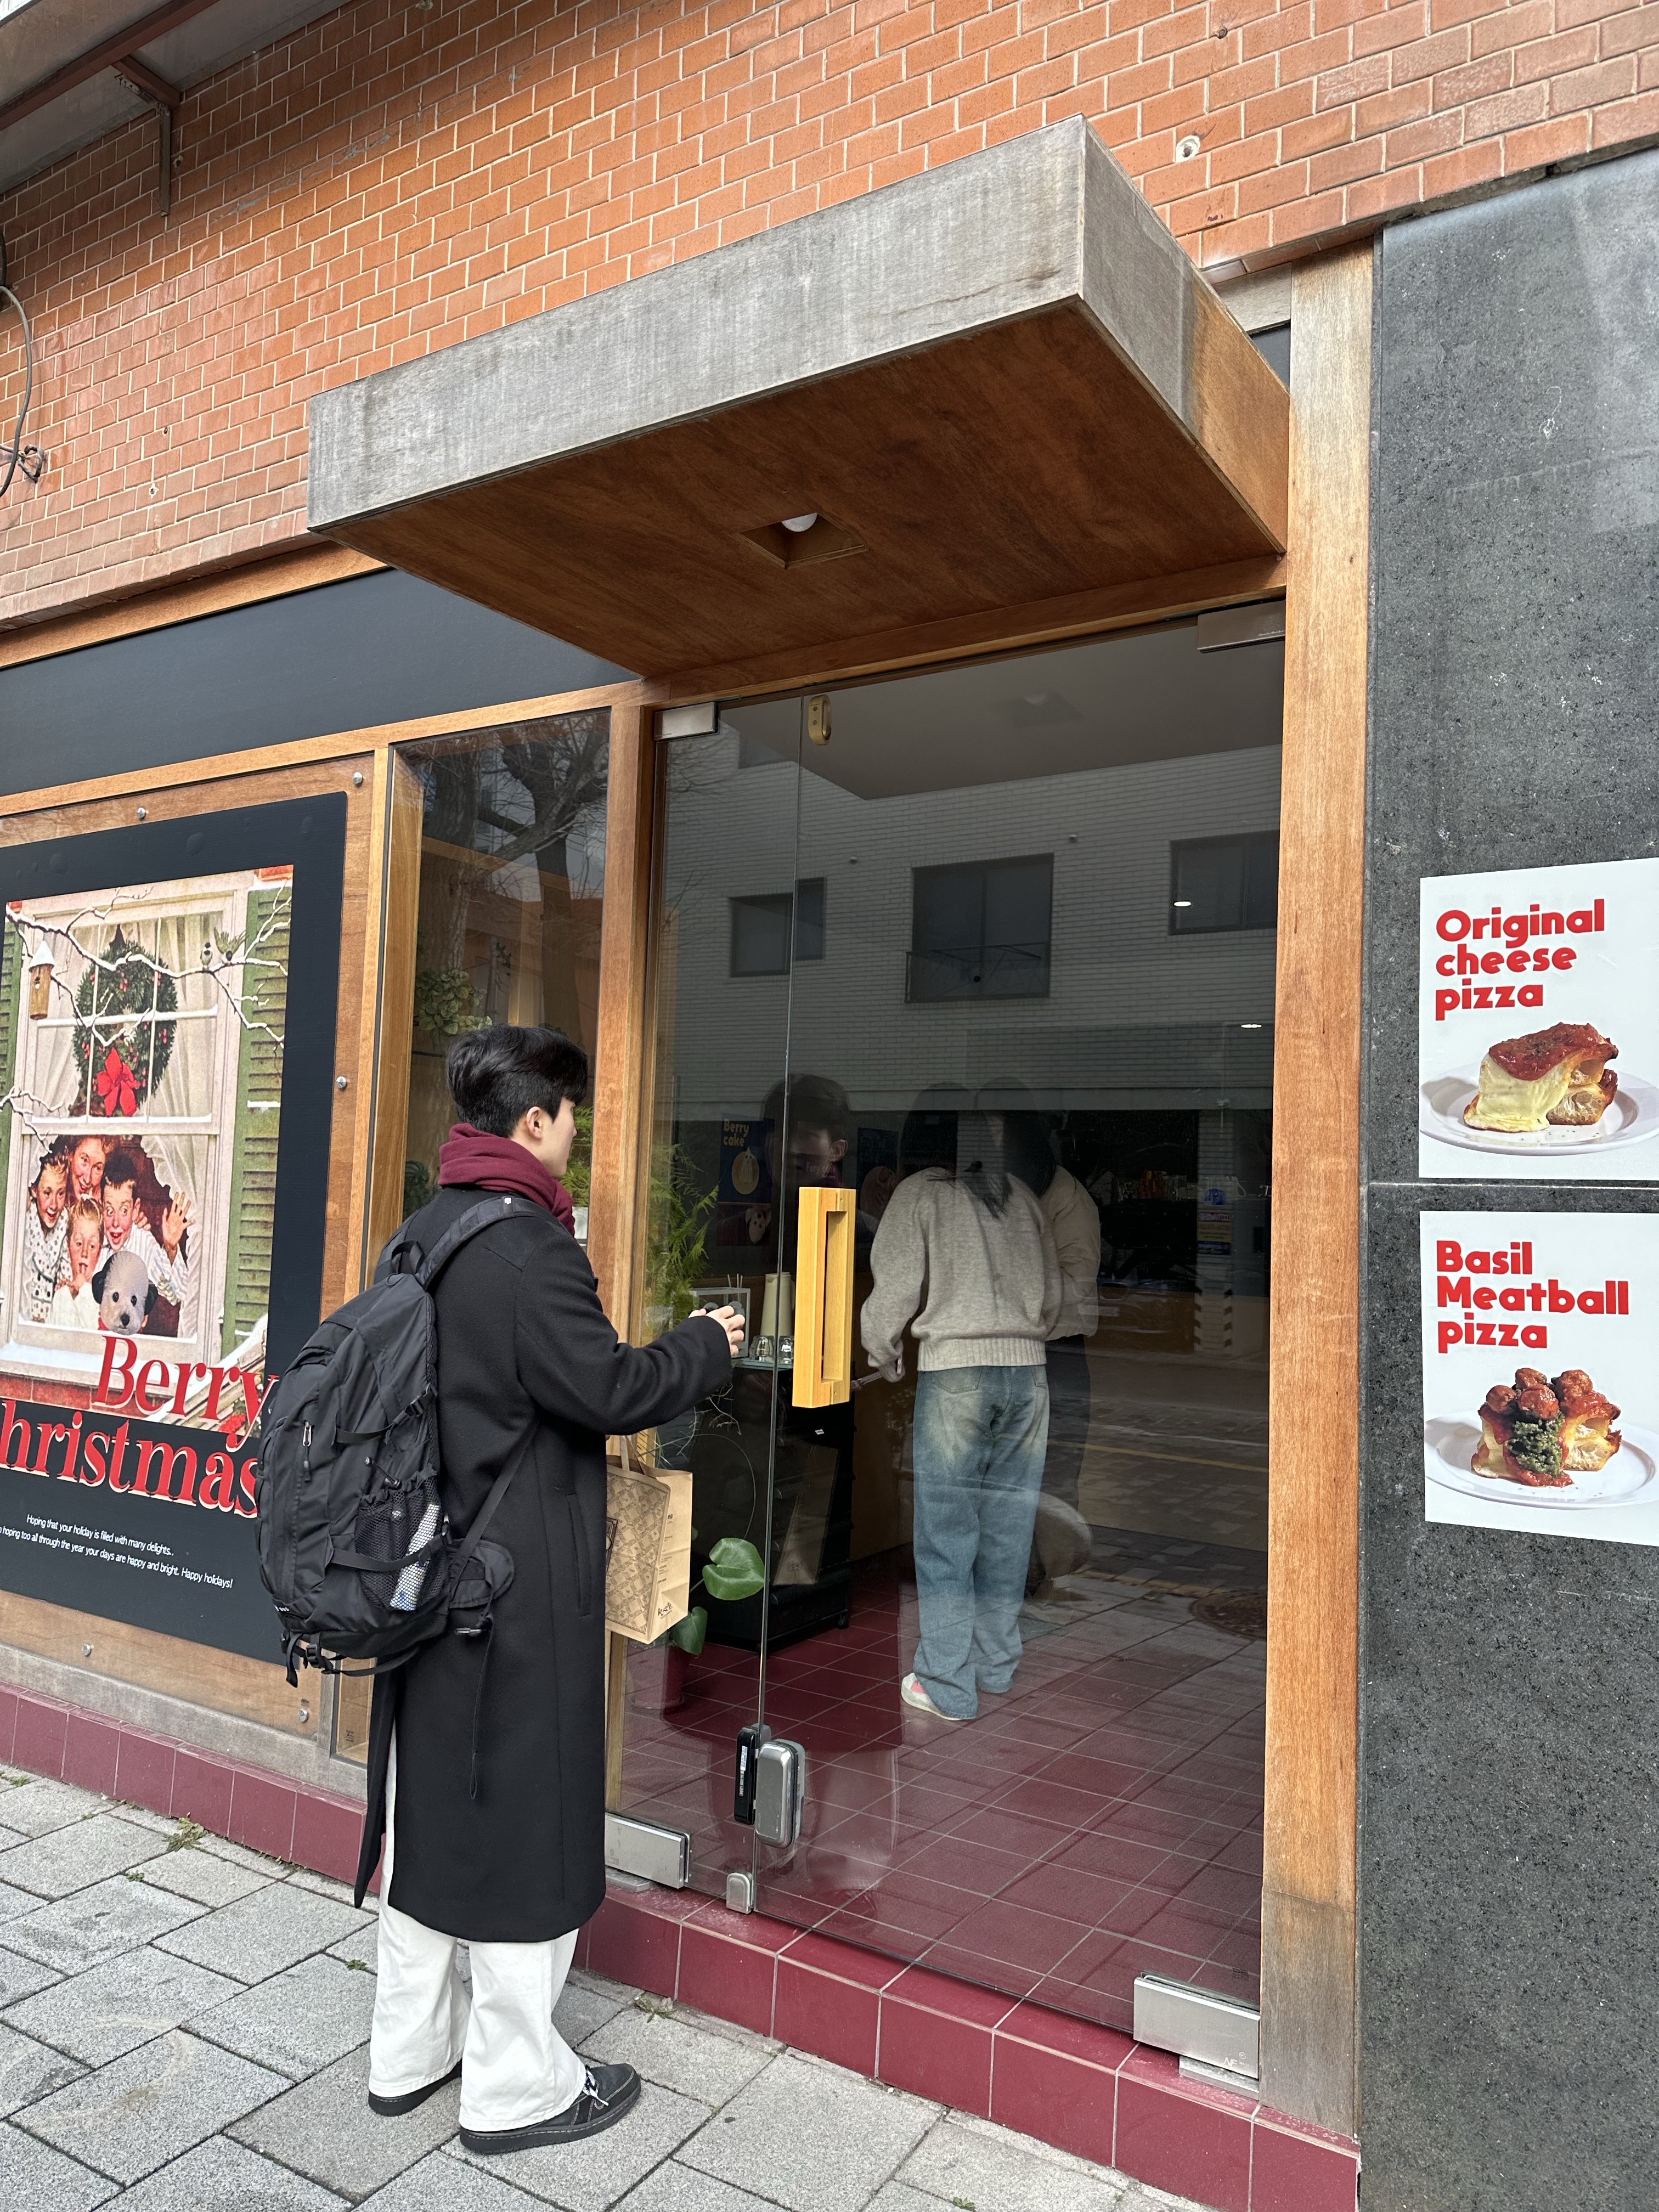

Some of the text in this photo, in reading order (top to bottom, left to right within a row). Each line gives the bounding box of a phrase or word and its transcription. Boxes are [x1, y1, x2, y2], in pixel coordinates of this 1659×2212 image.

[1436, 898, 1605, 949] Original
[1436, 943, 1577, 977] cheese
[1435, 978, 1543, 1021] pizza
[723, 1133, 744, 1147] cake
[724, 1118, 749, 1137] Berry
[1436, 1240, 1533, 1275] Basil
[1437, 1275, 1629, 1315] Meatball
[1438, 1312, 1547, 1353] pizza
[92, 1335, 280, 1453] Berry
[0, 1400, 258, 1519] hristmas
[26, 1514, 46, 1528] Hoping
[47, 1519, 59, 1530] that
[59, 1523, 74, 1533] your
[73, 1525, 94, 1539] holiday
[94, 1530, 100, 1539] is
[100, 1531, 115, 1543] filled
[115, 1535, 127, 1546] with
[128, 1539, 146, 1551] many
[3, 1526, 20, 1540] hoping
[21, 1531, 31, 1541] too
[39, 1534, 60, 1549] through
[61, 1539, 71, 1550] the
[71, 1543, 84, 1553] year
[85, 1547, 100, 1556] your
[100, 1549, 115, 1561] days
[115, 1554, 126, 1564] are
[127, 1555, 146, 1570] happy
[146, 1561, 159, 1571] and
[160, 1562, 179, 1577] bright.
[181, 1567, 204, 1583] Happy
[204, 1573, 233, 1589] holidays!
